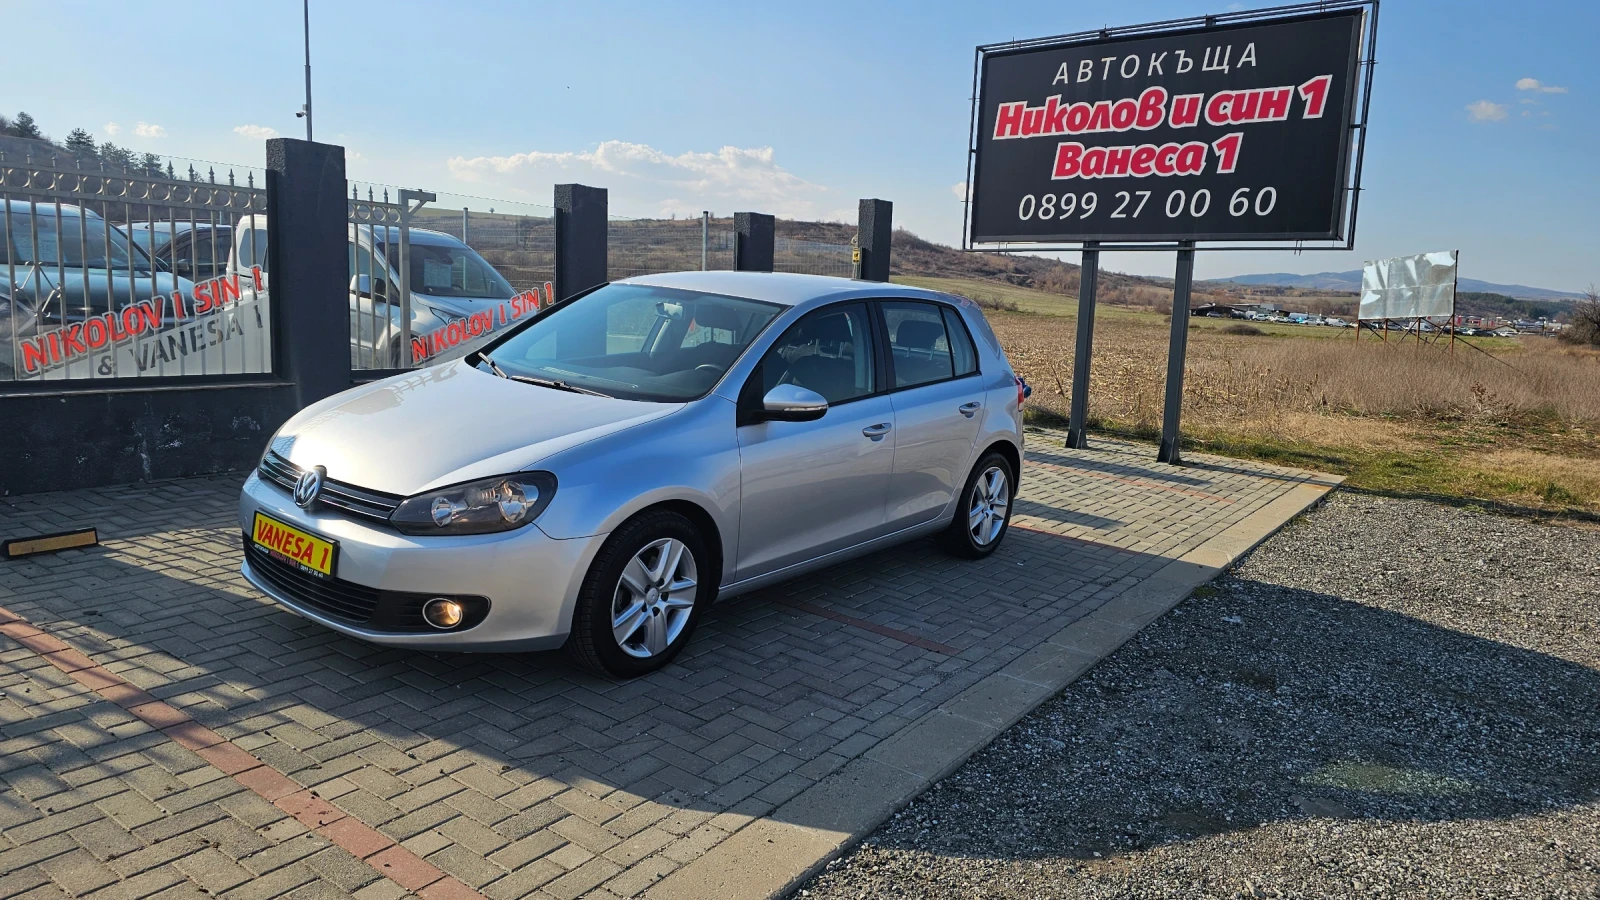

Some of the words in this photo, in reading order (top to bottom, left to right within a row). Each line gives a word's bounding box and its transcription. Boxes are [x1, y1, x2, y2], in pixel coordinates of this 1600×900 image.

[1052, 42, 1257, 85] АВТОКЪЩА
[993, 85, 1166, 140] Николов
[1169, 93, 1204, 129] и
[1204, 85, 1294, 126] син
[1298, 74, 1334, 119] 1
[1051, 141, 1208, 180] Ванеса
[1212, 132, 1244, 174] 1
[1018, 191, 1098, 221] 0899
[1110, 190, 1152, 219] 27
[1165, 188, 1211, 218] 00
[1228, 186, 1277, 217] 60
[19, 294, 165, 374] NIKOLOV
[193, 273, 242, 315] SIN
[98, 355, 116, 375] &
[128, 312, 244, 371] VANESA
[410, 308, 495, 362] NIKOLOV
[510, 287, 541, 320] SIN
[257, 519, 315, 565] VANESA
[319, 547, 329, 570] 1
